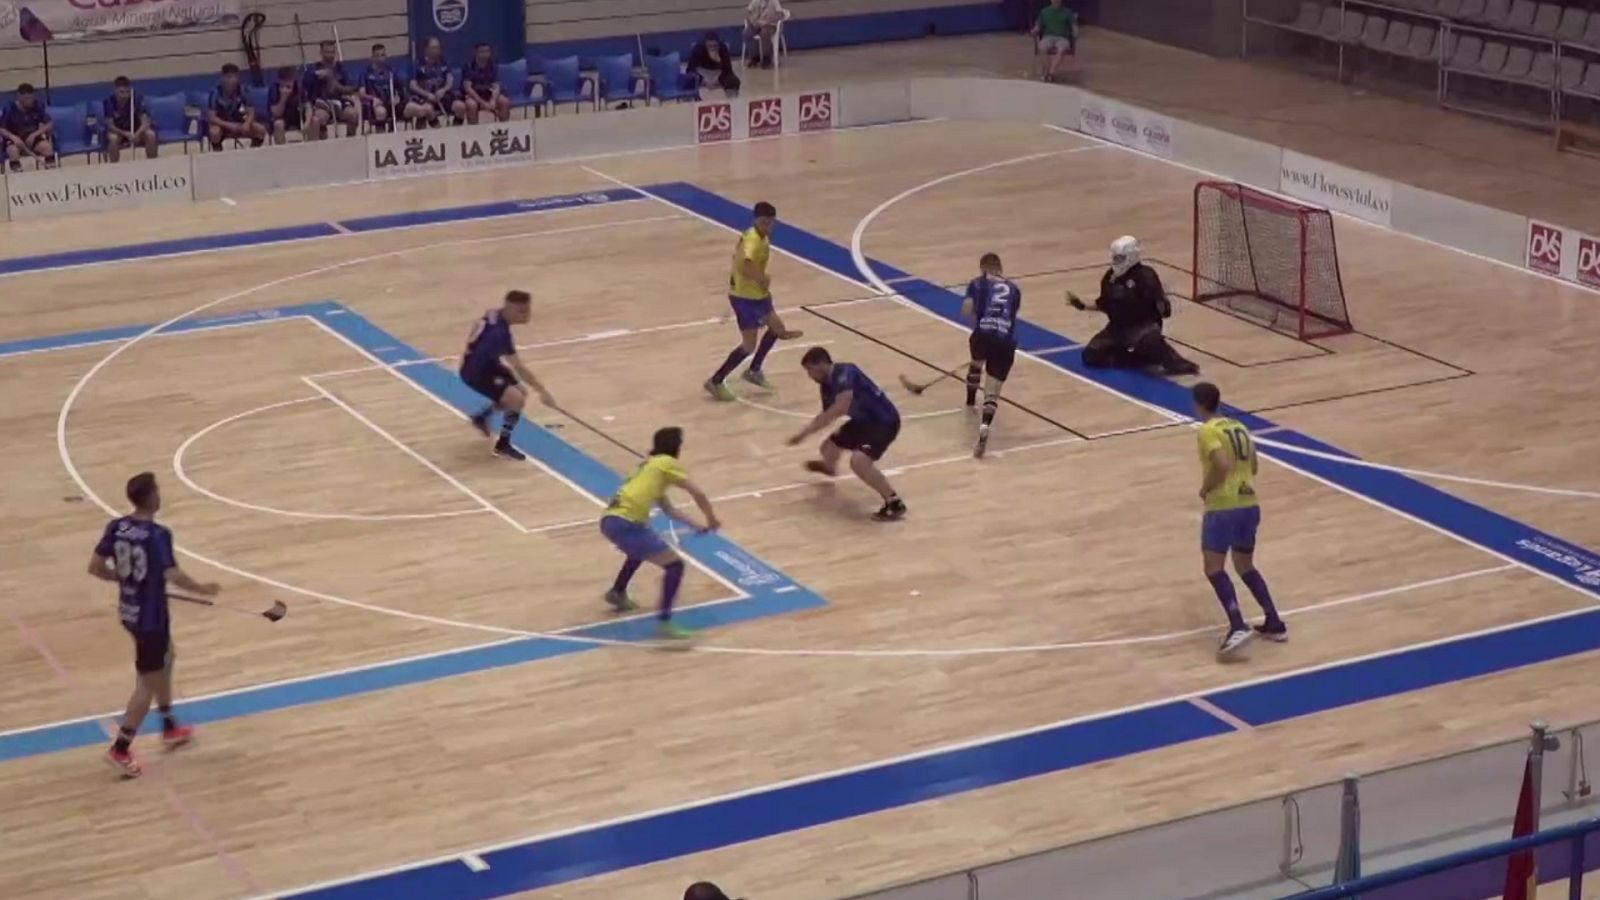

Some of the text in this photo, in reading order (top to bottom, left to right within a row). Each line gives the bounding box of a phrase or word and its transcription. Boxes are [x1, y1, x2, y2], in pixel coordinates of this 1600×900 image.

[112, 9, 162, 25] Mineral
[168, 4, 220, 20] Natural
[375, 149, 398, 168] LA
[461, 140, 484, 159] LA
[992, 283, 1011, 303] 2
[1223, 427, 1251, 461] 10
